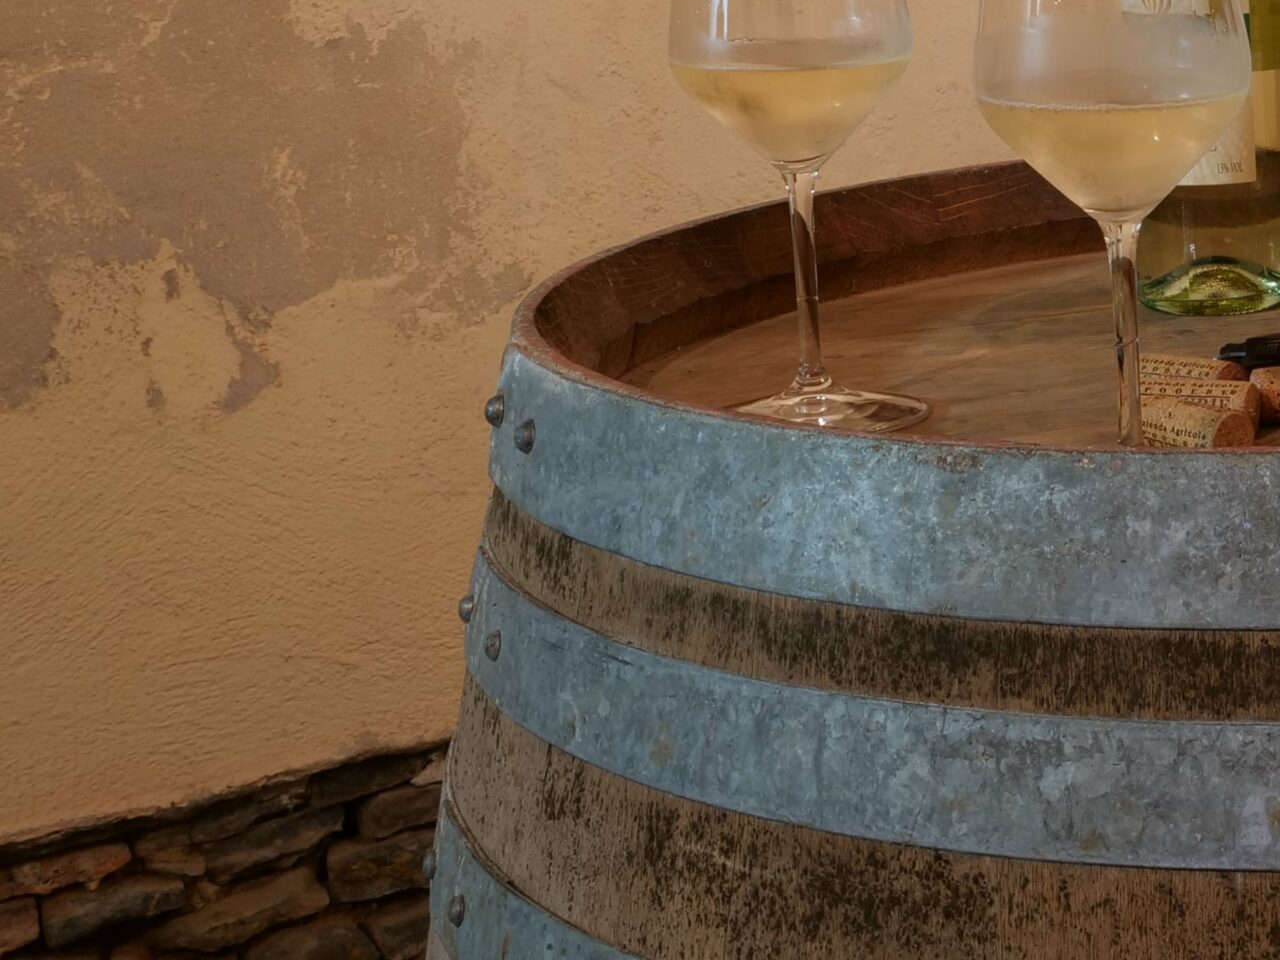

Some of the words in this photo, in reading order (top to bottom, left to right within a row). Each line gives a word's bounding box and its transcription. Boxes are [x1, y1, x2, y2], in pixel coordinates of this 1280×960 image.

[1229, 161, 1244, 173] VOL
[1141, 419, 1167, 433] zienda
[1170, 426, 1207, 441] Agricola
